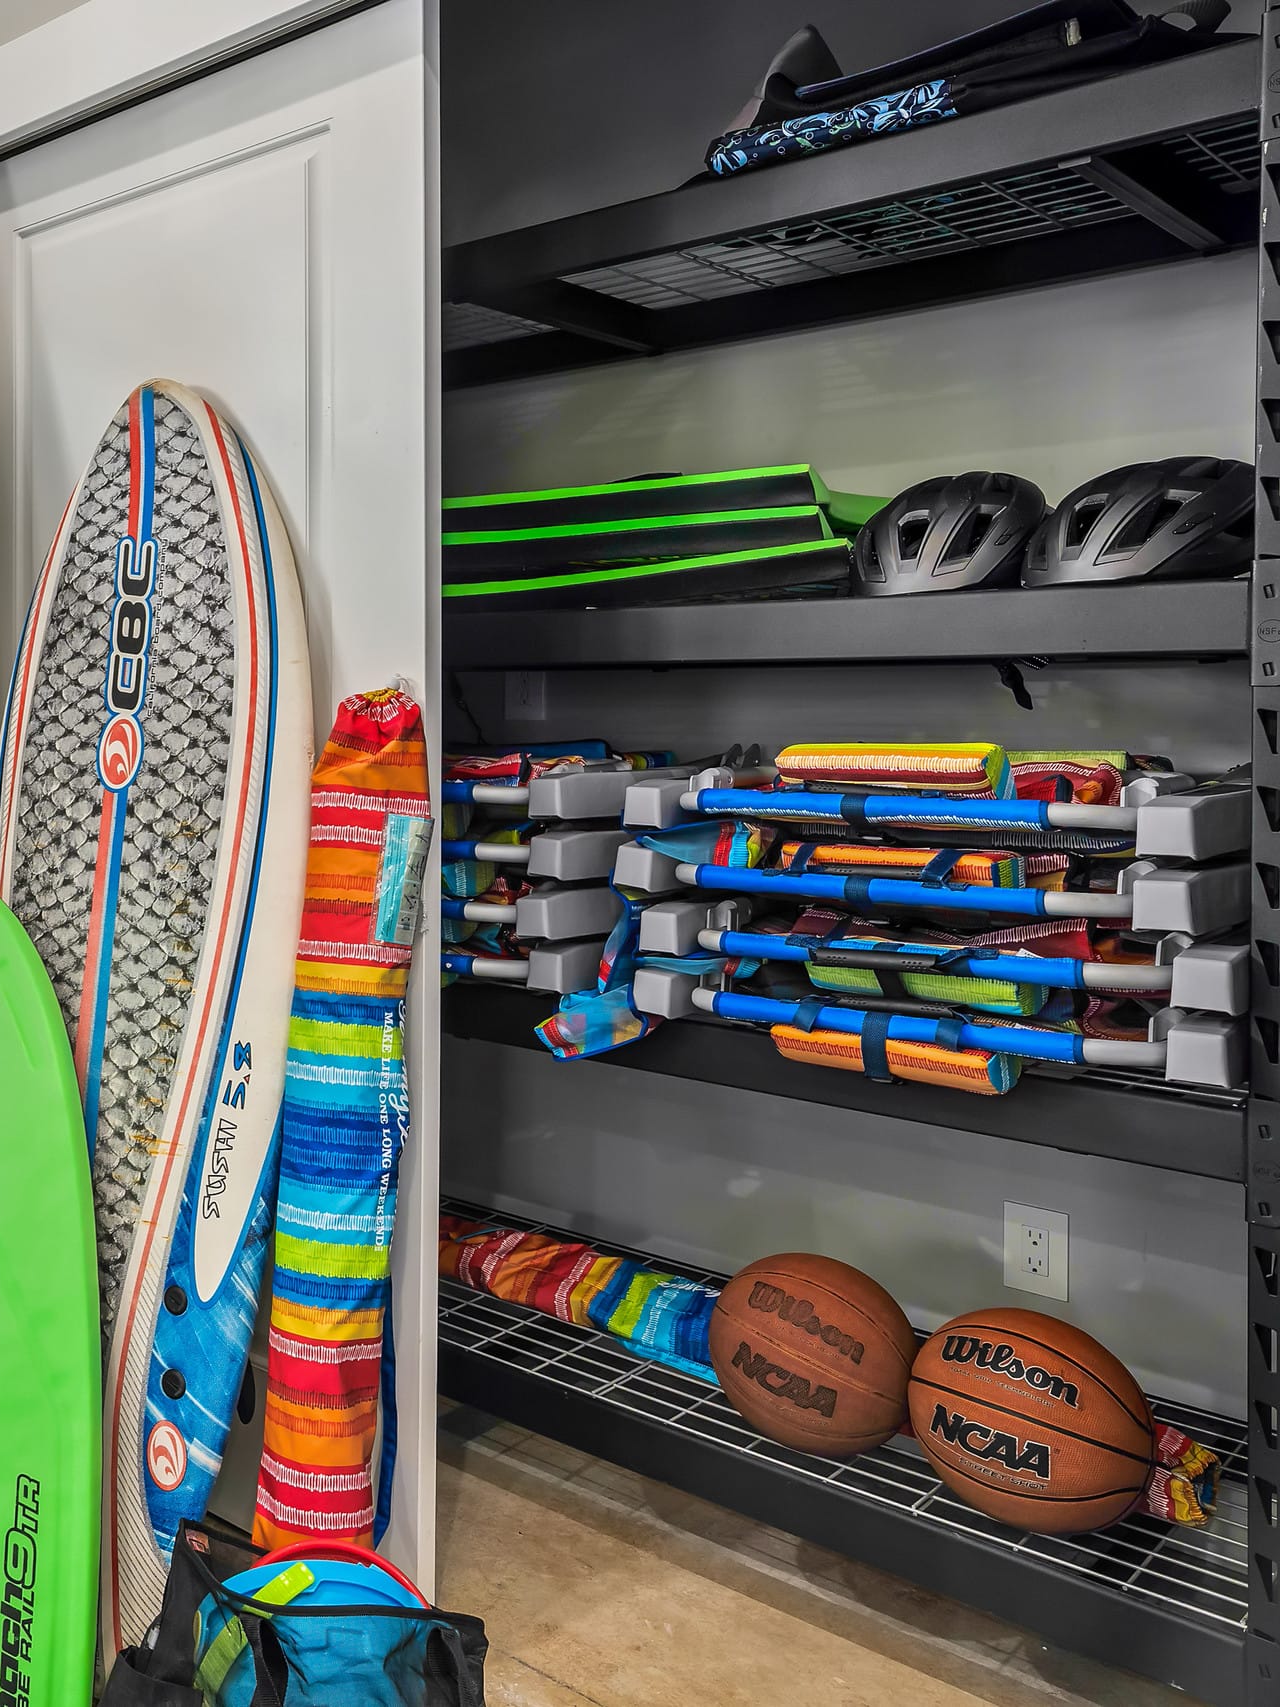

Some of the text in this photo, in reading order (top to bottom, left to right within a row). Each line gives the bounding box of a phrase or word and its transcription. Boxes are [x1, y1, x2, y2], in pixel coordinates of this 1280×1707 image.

[107, 541, 156, 713] CBC
[147, 538, 169, 717] california board company
[381, 1012, 393, 1053] MAKE
[378, 1092, 389, 1125] ONE
[379, 1057, 391, 1090] LIFE
[202, 1040, 252, 1220] SUSHI 5.8
[381, 1129, 393, 1169] LONG
[747, 1280, 865, 1366] Wilson
[731, 1340, 838, 1419] NCAA
[941, 1336, 1080, 1410] Wilson
[930, 1403, 1051, 1480] NCAA
[19, 1591, 35, 1664] RAIL
